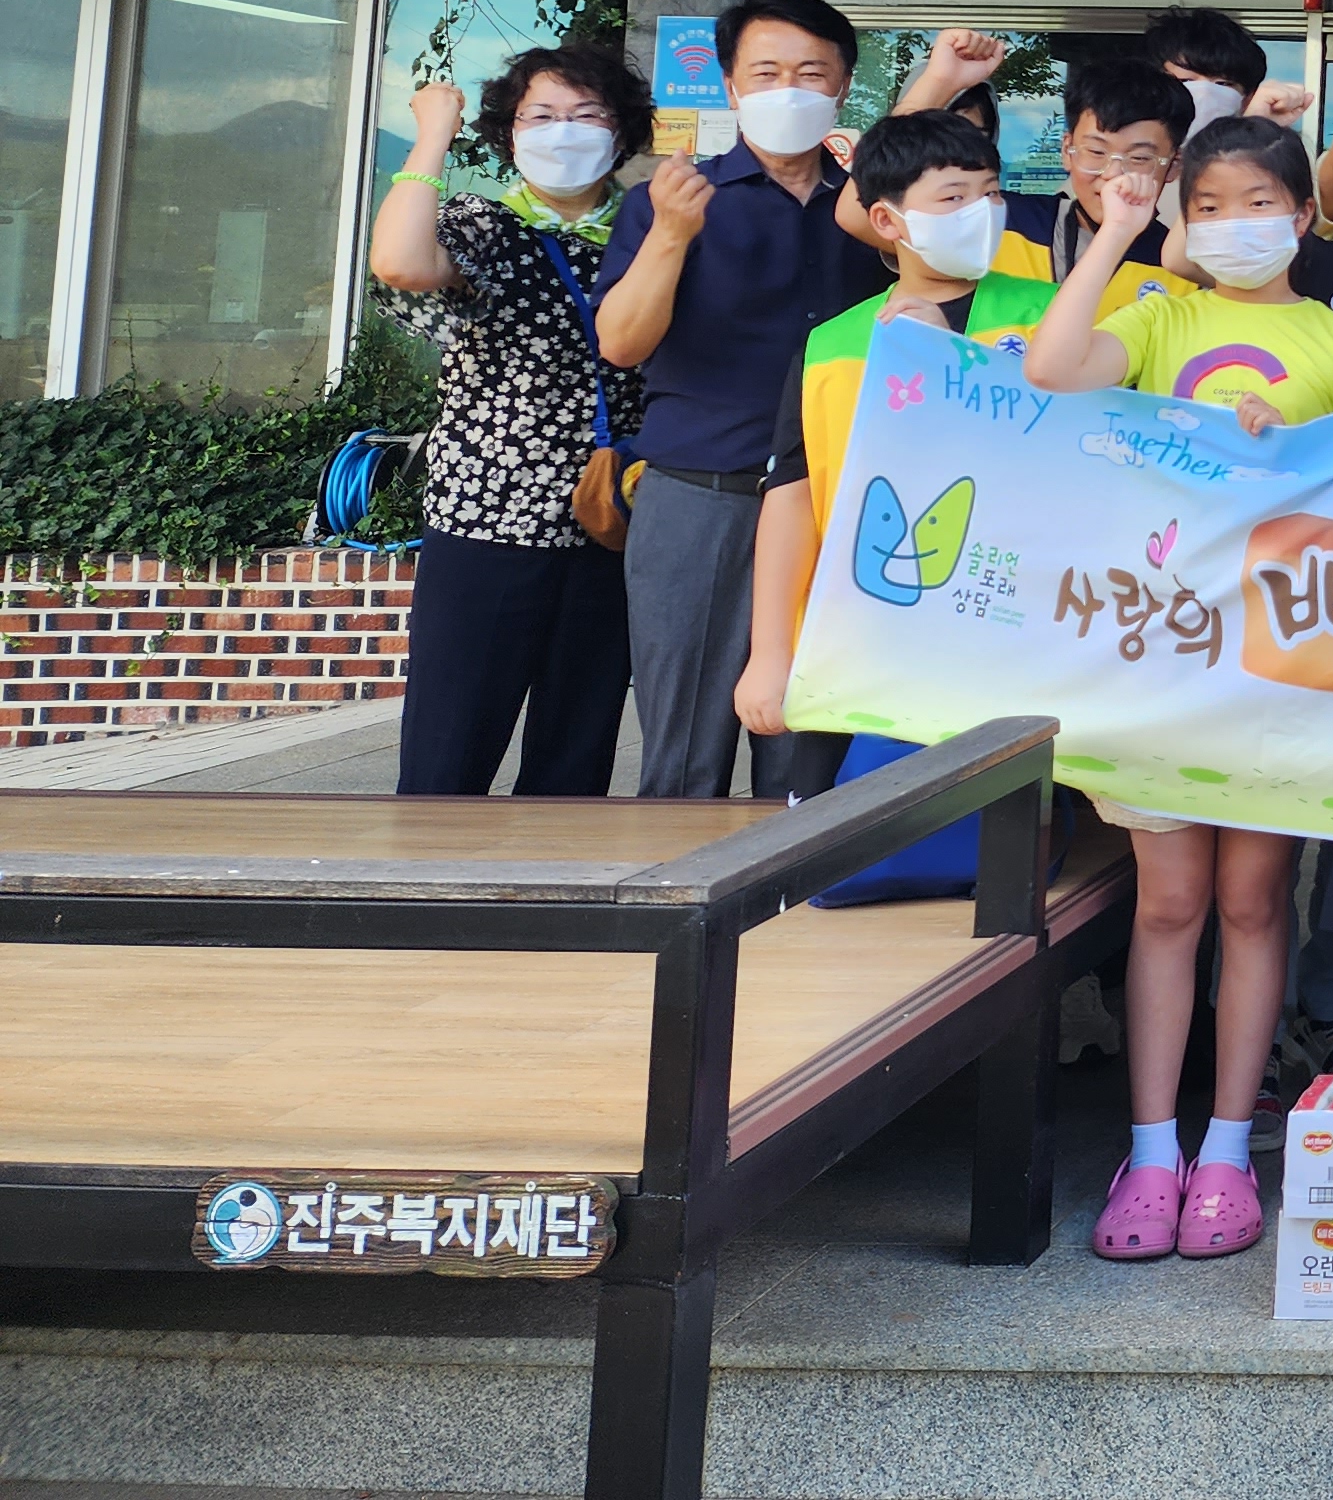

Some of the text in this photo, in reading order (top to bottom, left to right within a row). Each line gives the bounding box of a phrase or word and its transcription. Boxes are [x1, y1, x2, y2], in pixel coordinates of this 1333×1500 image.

[943, 365, 1053, 434] HAPPY
[952, 588, 991, 618] 상담
[1054, 565, 1223, 669] 사랑의
[287, 1192, 597, 1258] 진주복지재단
[1302, 1282, 1332, 1294] 드링크
